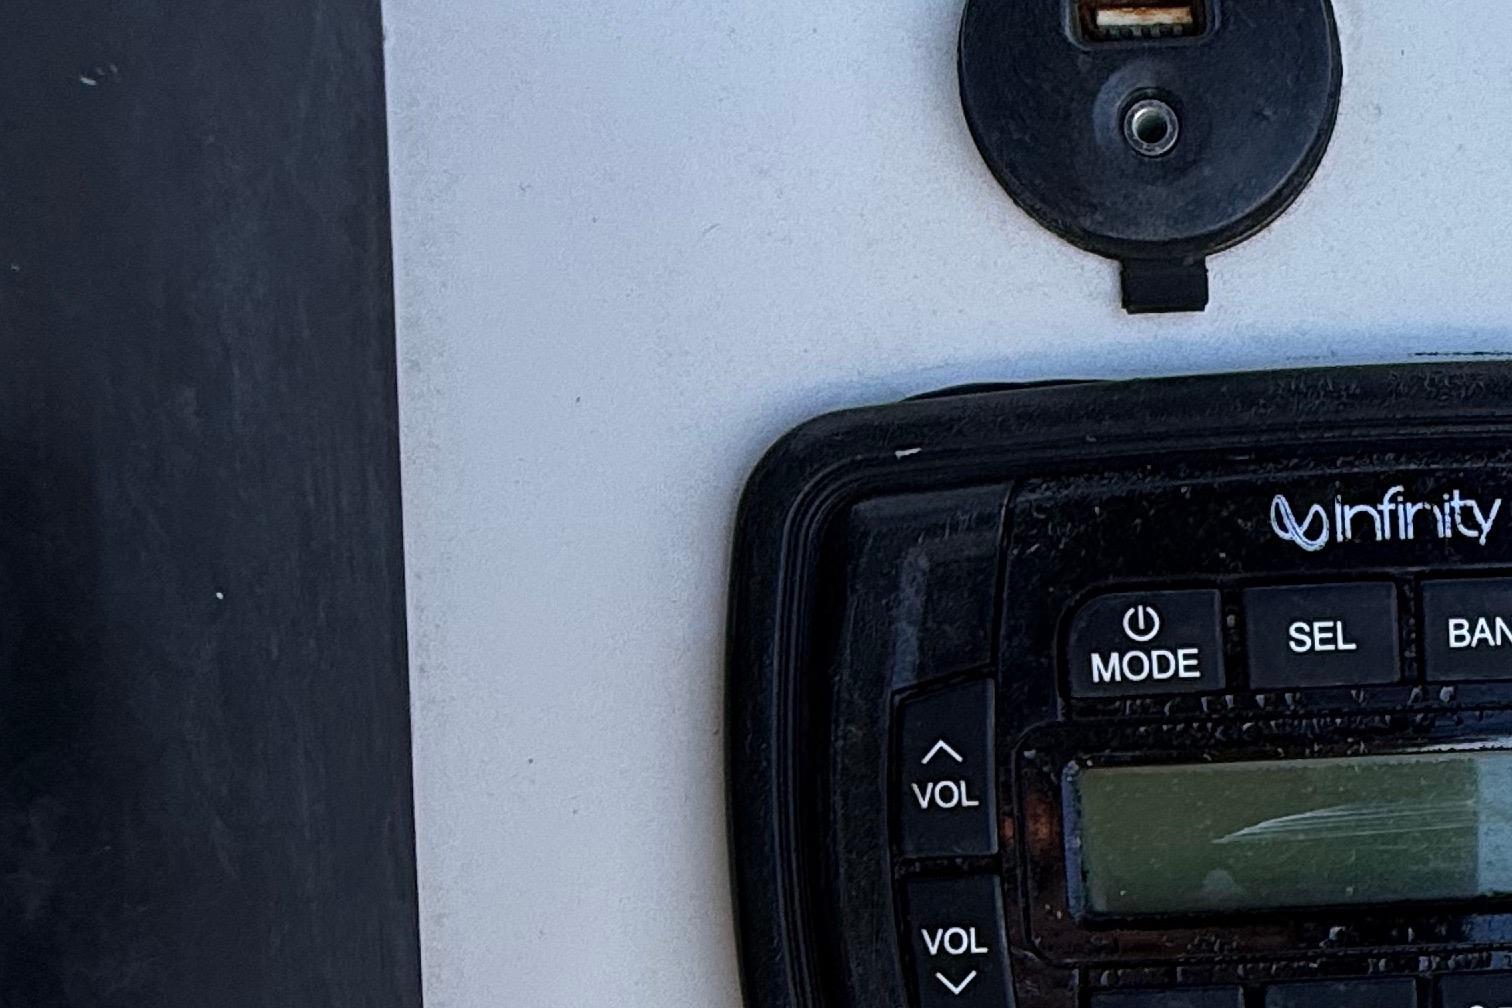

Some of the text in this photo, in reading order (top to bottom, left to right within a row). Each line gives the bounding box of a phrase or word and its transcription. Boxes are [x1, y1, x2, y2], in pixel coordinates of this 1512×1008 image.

[1288, 621, 1357, 653] SEL
[1091, 648, 1201, 683] MODE
[912, 780, 979, 809] VOL
[921, 926, 988, 955] VOL
